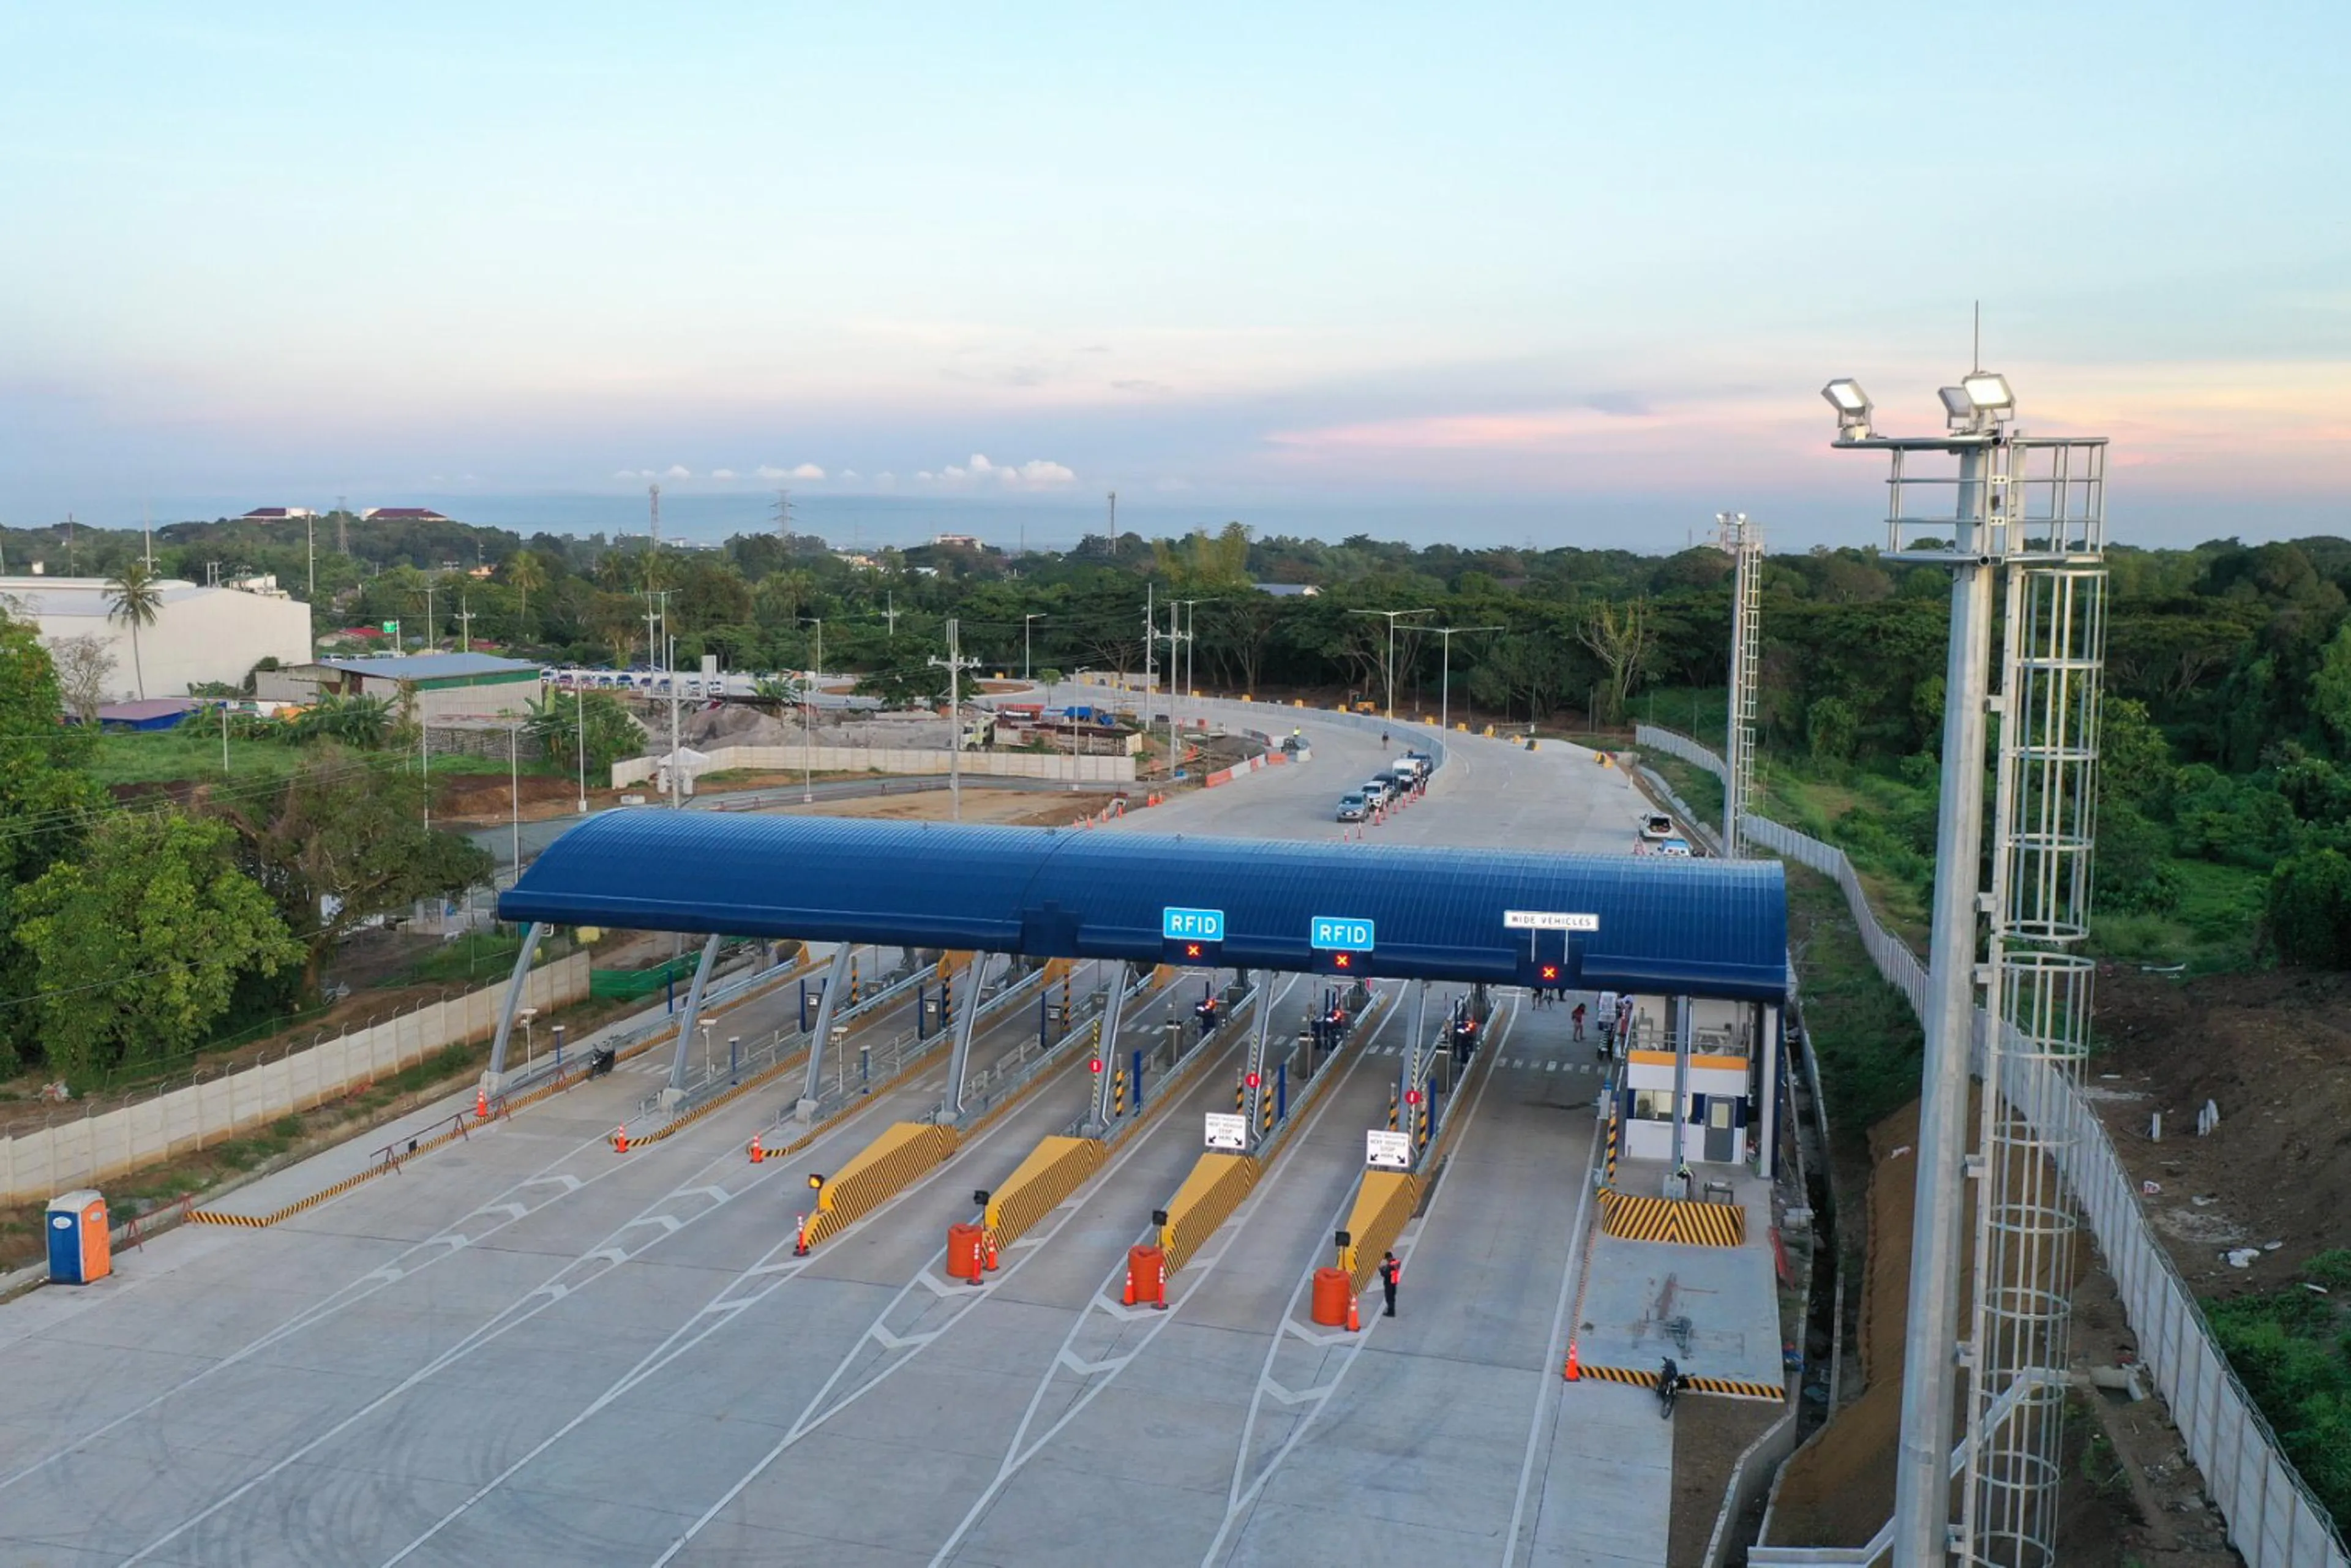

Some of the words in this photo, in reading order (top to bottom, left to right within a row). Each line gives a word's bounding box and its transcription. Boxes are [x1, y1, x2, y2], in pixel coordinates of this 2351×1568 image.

[1171, 914, 1217, 934] RFID
[1540, 916, 1591, 926] VEHICLES
[1319, 924, 1367, 943] RFID
